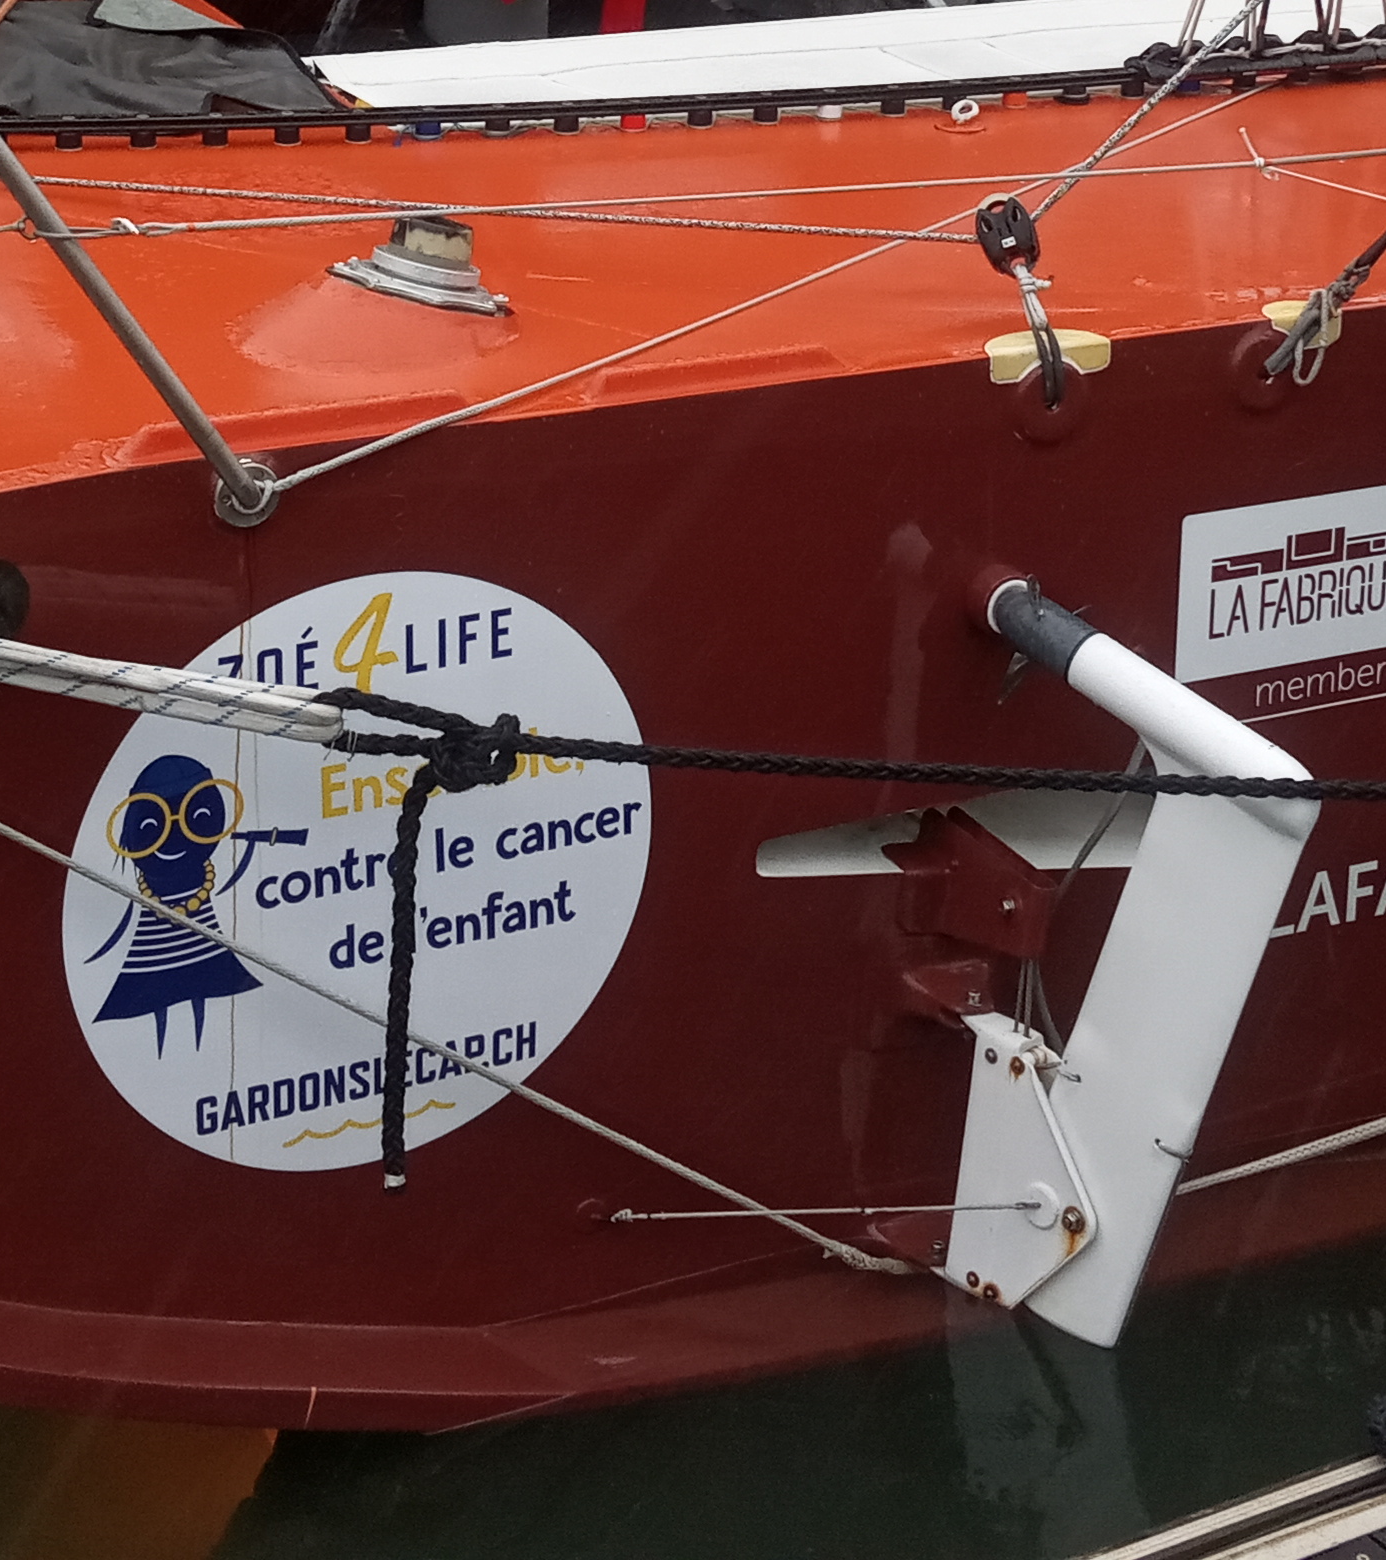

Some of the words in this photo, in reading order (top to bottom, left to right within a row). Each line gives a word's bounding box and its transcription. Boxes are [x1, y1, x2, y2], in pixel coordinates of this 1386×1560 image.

[333, 592, 399, 694] 4
[405, 607, 514, 674] LIFE
[1209, 583, 1250, 640] LA
[255, 845, 408, 910] contr
[434, 826, 475, 873] le
[496, 799, 643, 861] cancer
[329, 923, 385, 970] de
[413, 880, 576, 951] 'enfant
